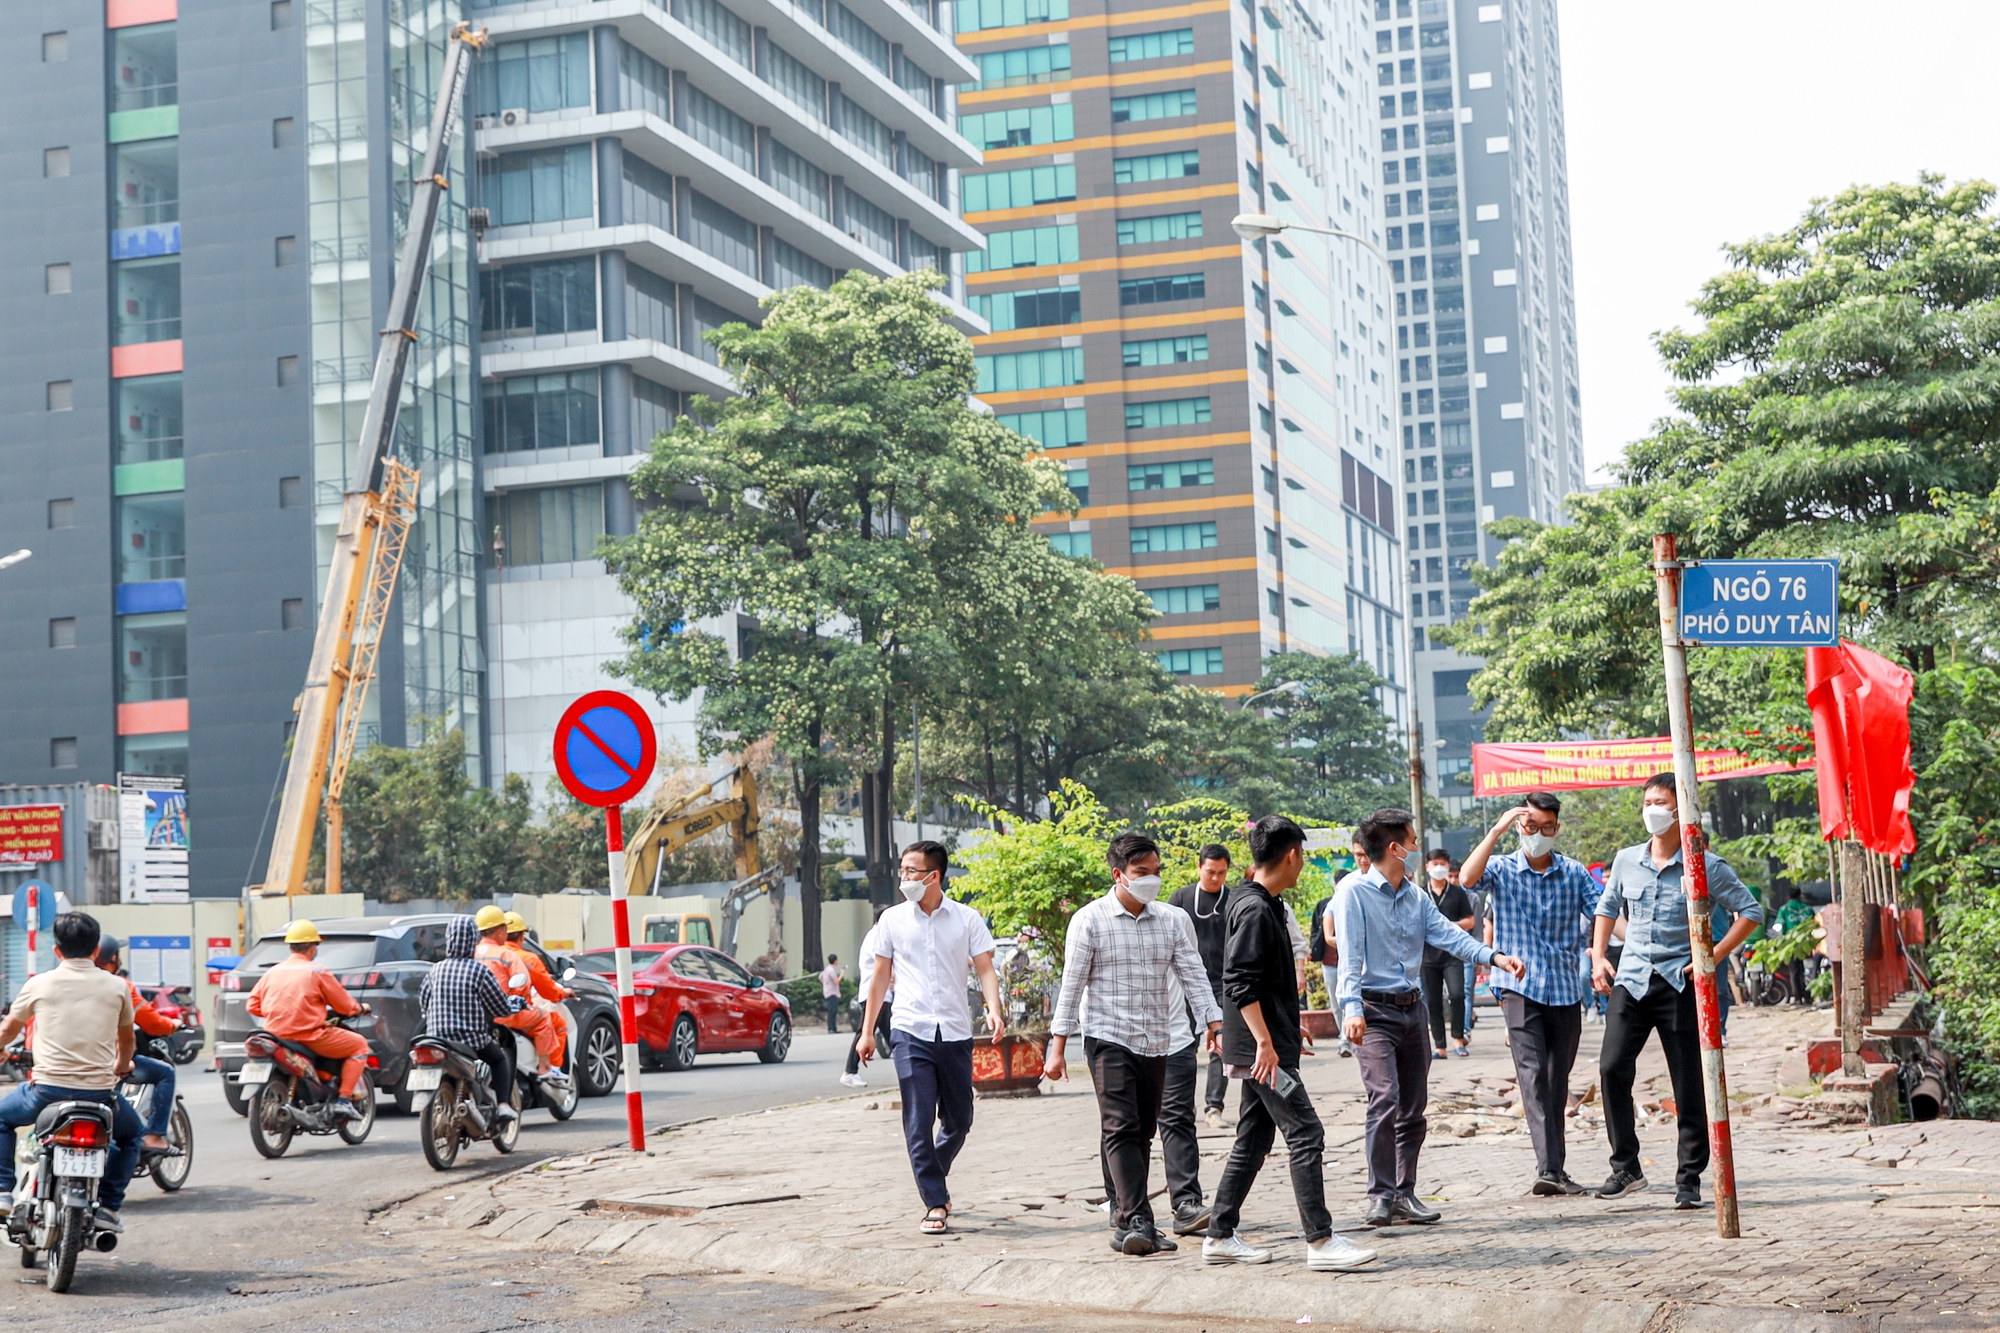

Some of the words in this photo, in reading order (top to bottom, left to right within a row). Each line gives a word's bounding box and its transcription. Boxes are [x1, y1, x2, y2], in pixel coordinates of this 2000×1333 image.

[1713, 569, 1771, 601] NGÕ
[1779, 576, 1807, 601] 76
[1684, 608, 1730, 634] PHỐ
[1736, 615, 1781, 634] DUY
[1787, 610, 1830, 634] TÂN
[1582, 744, 1607, 762] LIỆT
[1483, 770, 1499, 789] VÀ
[1500, 768, 1539, 788] THÁNG
[1542, 766, 1575, 785] HÀNH
[1578, 763, 1612, 785] ĐỘNG
[1633, 763, 1651, 778] AN
[1713, 754, 1745, 772] SINH
[61, 1148, 97, 1161] 29-F8
[61, 1161, 97, 1175] 7475
